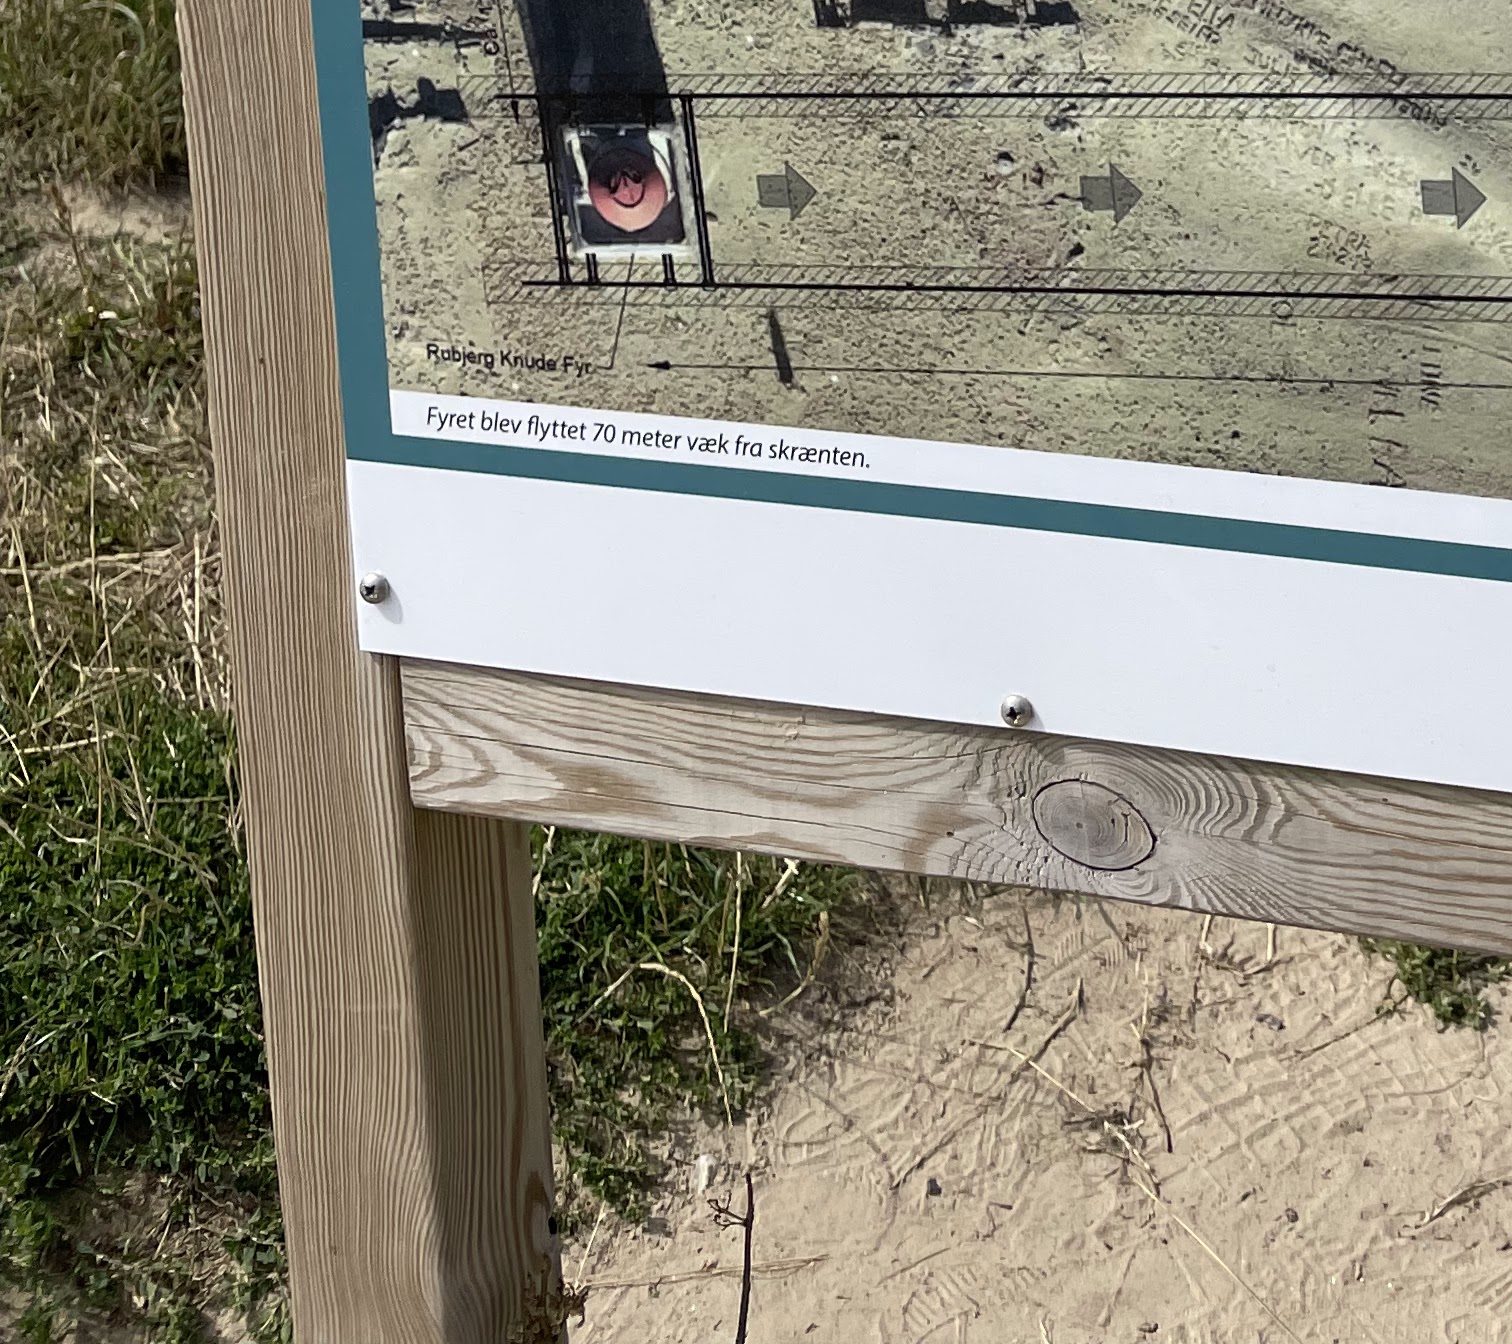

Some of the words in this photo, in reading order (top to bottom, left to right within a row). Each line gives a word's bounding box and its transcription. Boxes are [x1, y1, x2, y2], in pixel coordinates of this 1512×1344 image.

[499, 350, 558, 372] Knude
[562, 355, 593, 378] Fyr
[427, 406, 476, 432] Fyret
[480, 410, 522, 434] blev
[527, 415, 585, 442] flyttet
[592, 423, 616, 444] 70
[621, 430, 682, 450] meter
[687, 433, 729, 455] væk
[735, 434, 763, 458] fra
[768, 438, 872, 470] skrænten.
